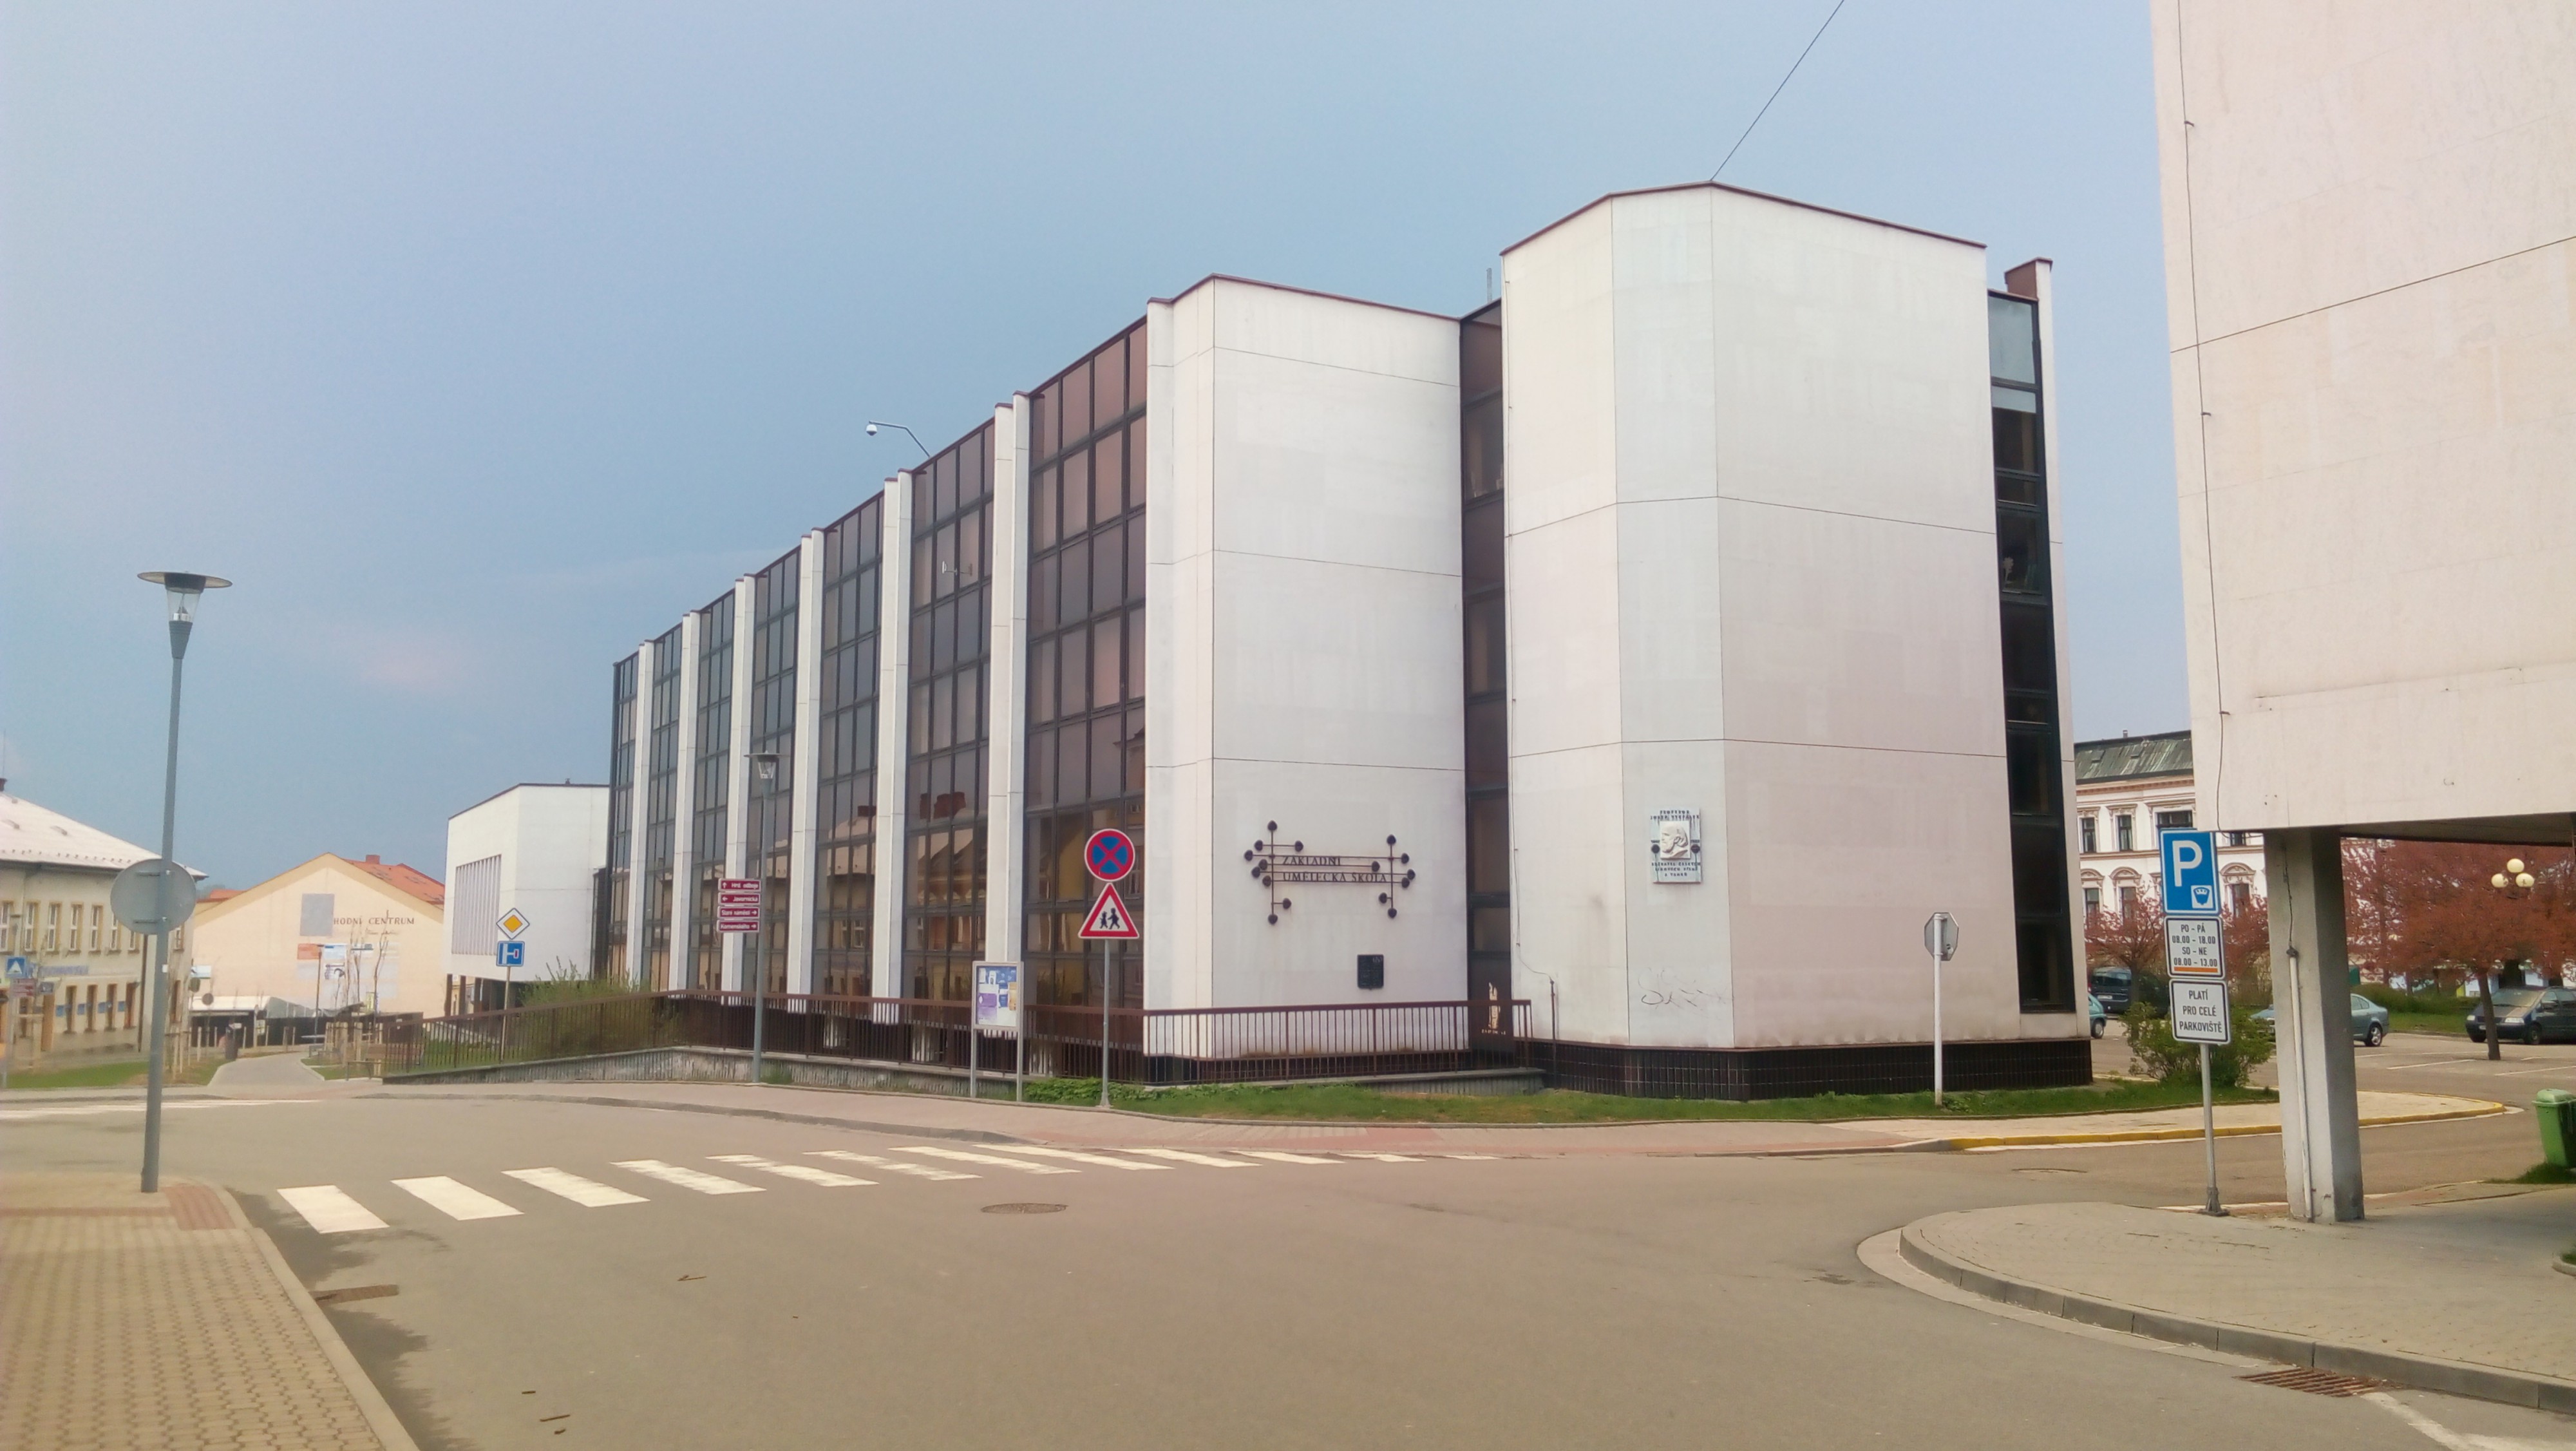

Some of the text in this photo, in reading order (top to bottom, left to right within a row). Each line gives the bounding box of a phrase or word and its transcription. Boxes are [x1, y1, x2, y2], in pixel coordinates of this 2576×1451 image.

[2172, 840, 2203, 887] P
[368, 916, 415, 925] CENTRUM
[2181, 924, 2189, 933] PO
[2197, 922, 2205, 933] PÁ
[2172, 935, 2190, 944] 08.00
[2199, 936, 2216, 944] 18.00
[2199, 947, 2207, 955] NE
[2174, 958, 2192, 966] 08.00
[2200, 958, 2217, 967] 13.00
[2188, 989, 2208, 1000] PLATÍ
[2183, 1005, 2217, 1016] PRO CELÉ
[2179, 1020, 2222, 1032] PARKOVIŠTĚ
